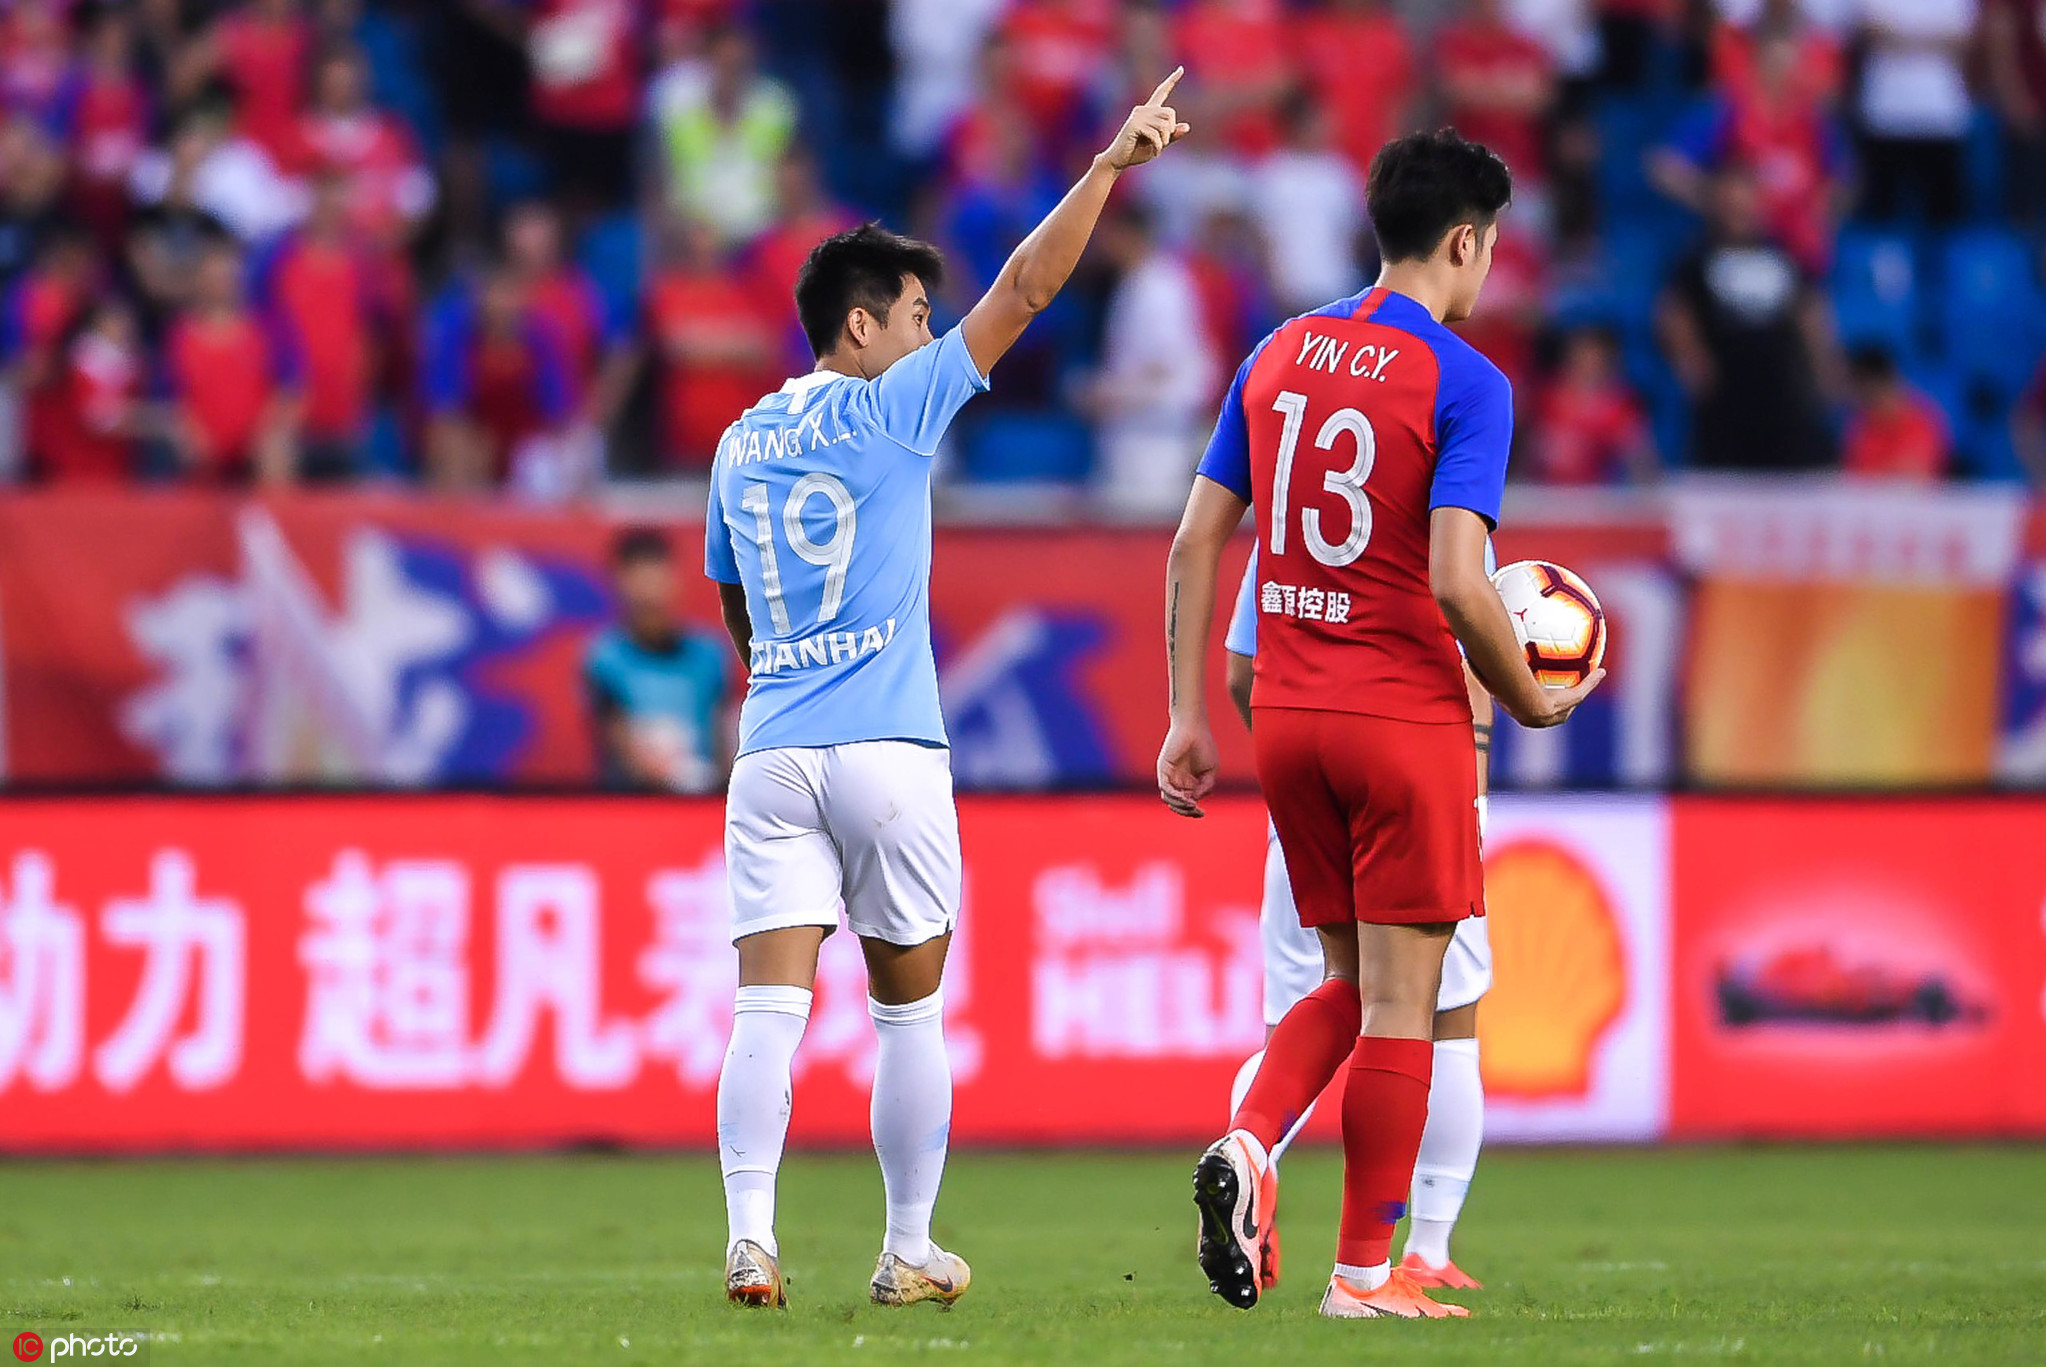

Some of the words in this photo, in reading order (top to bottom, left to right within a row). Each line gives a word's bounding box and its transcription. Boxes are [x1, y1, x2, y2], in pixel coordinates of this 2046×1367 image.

[1296, 330, 1349, 375] YIN
[1350, 345, 1399, 383] C.Y.
[728, 426, 803, 469] WANG
[1270, 390, 1376, 568] 13
[741, 472, 857, 636] 19
